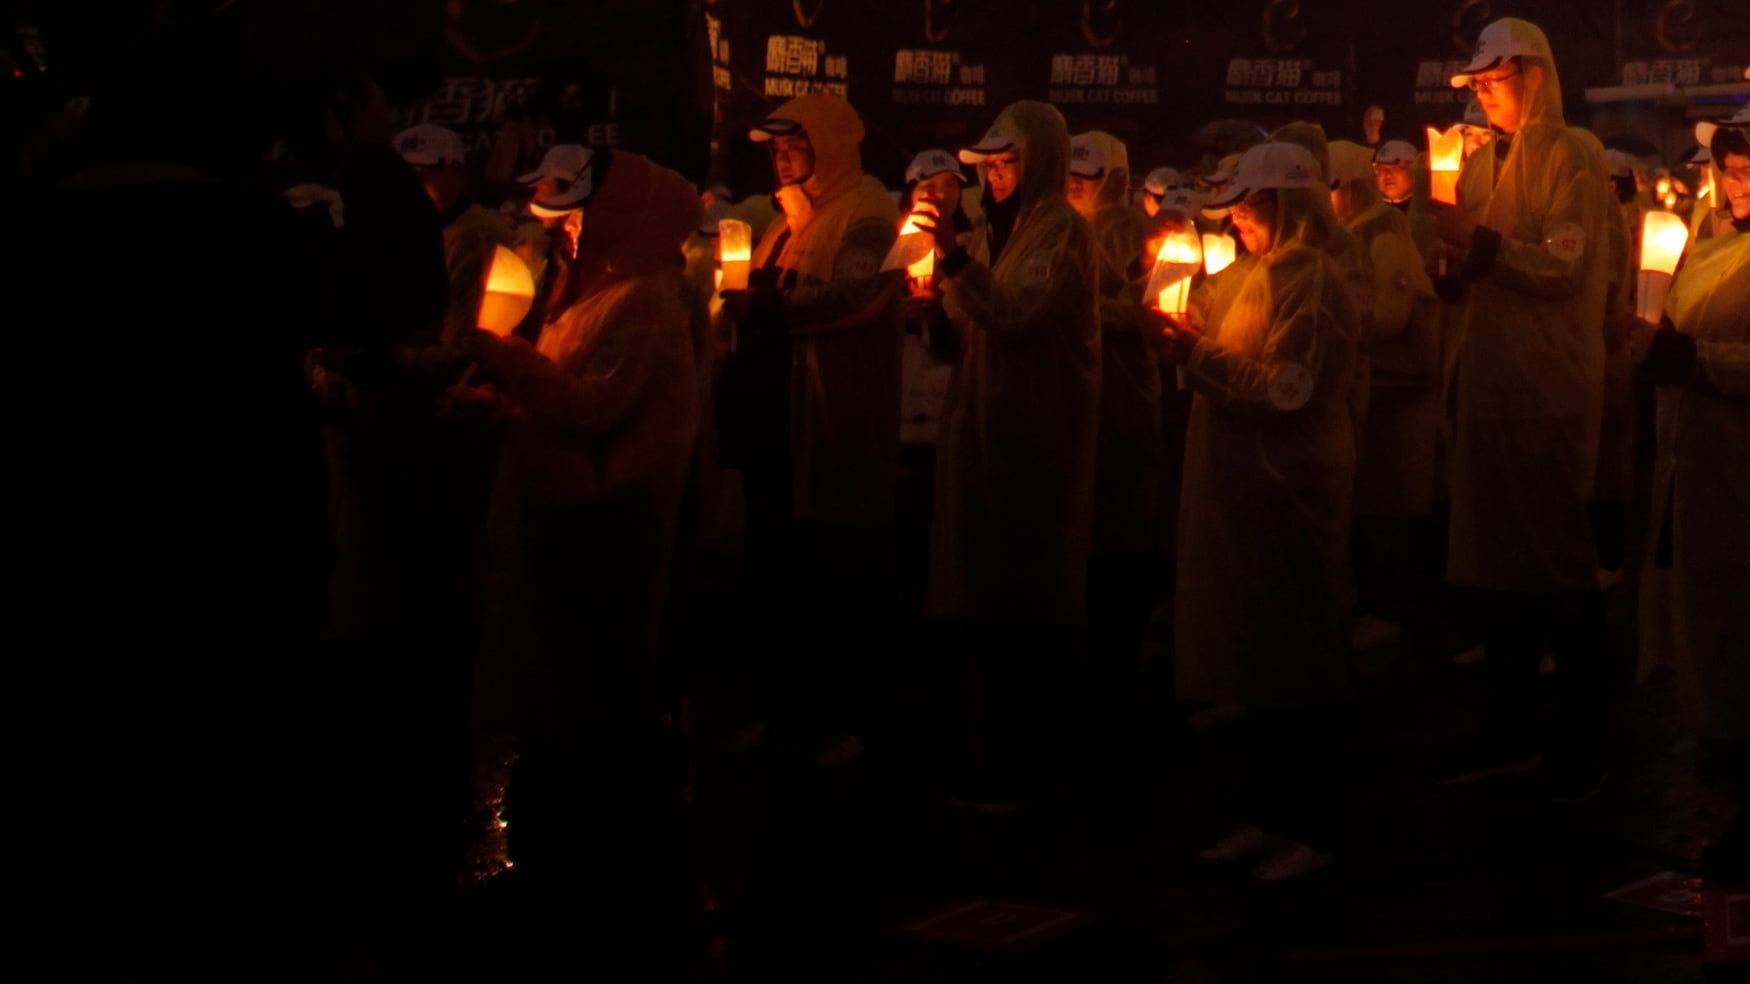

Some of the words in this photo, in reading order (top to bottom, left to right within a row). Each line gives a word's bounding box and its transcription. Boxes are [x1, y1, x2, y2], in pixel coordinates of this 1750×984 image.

[944, 88, 985, 106] COFFEE
[1113, 88, 1159, 104] COFFEE
[1265, 90, 1291, 104] CAT
[1294, 90, 1342, 105] COFFEE
